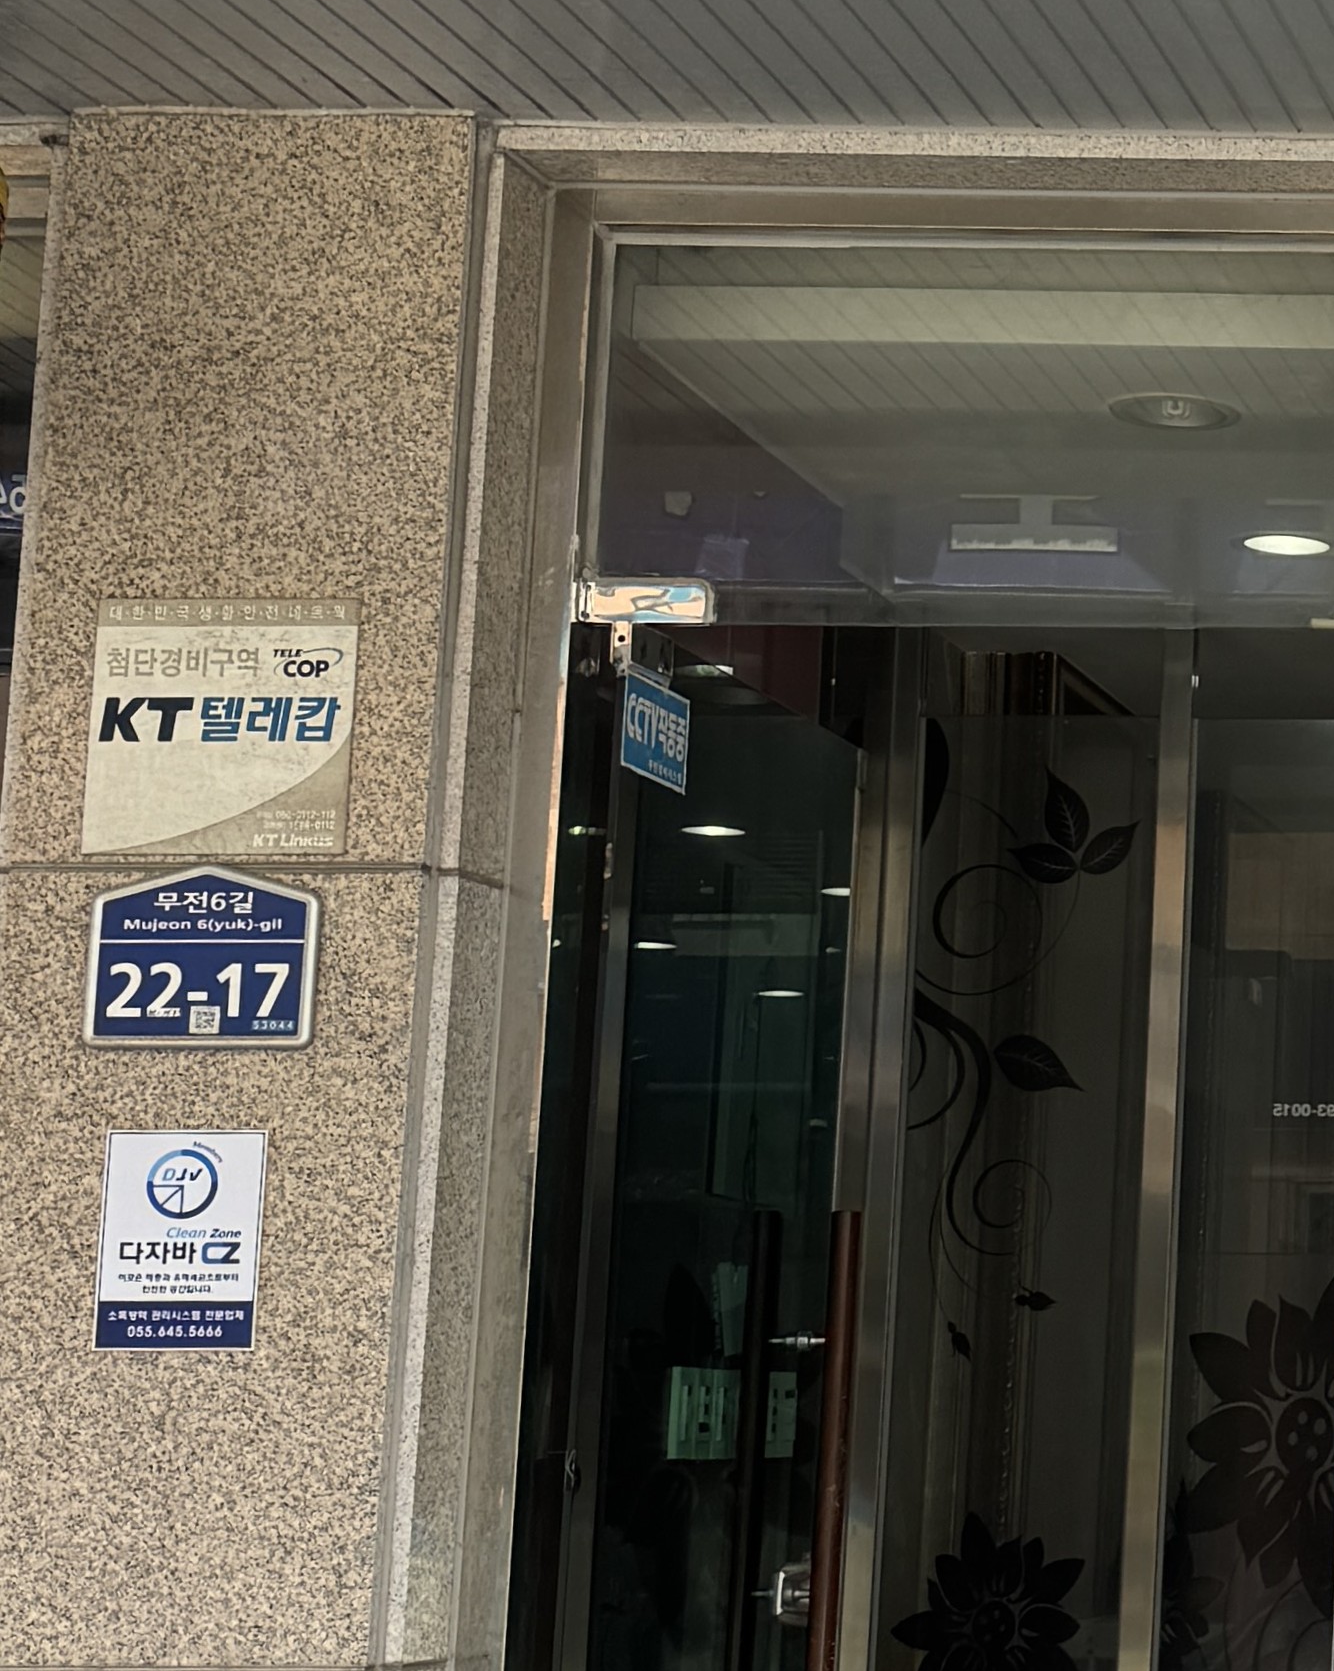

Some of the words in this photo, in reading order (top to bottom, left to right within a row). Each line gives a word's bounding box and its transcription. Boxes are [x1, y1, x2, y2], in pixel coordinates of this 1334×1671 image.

[106, 646, 261, 678] 첨단경비구역
[273, 648, 303, 659] TELE
[283, 660, 330, 678] COP
[98, 697, 195, 742] KT
[200, 697, 342, 742] 텔레캅
[252, 833, 279, 847] KT
[153, 891, 254, 914] 무전6길
[123, 918, 191, 932] Mujeon
[197, 918, 282, 932] 6(yuk)-gil
[106, 962, 290, 1018] 22-17
[166, 1227, 206, 1239] Clean
[209, 1227, 242, 1239] Zone
[119, 1241, 197, 1265] 다자바
[127, 1325, 223, 1338] 055.645.5666
